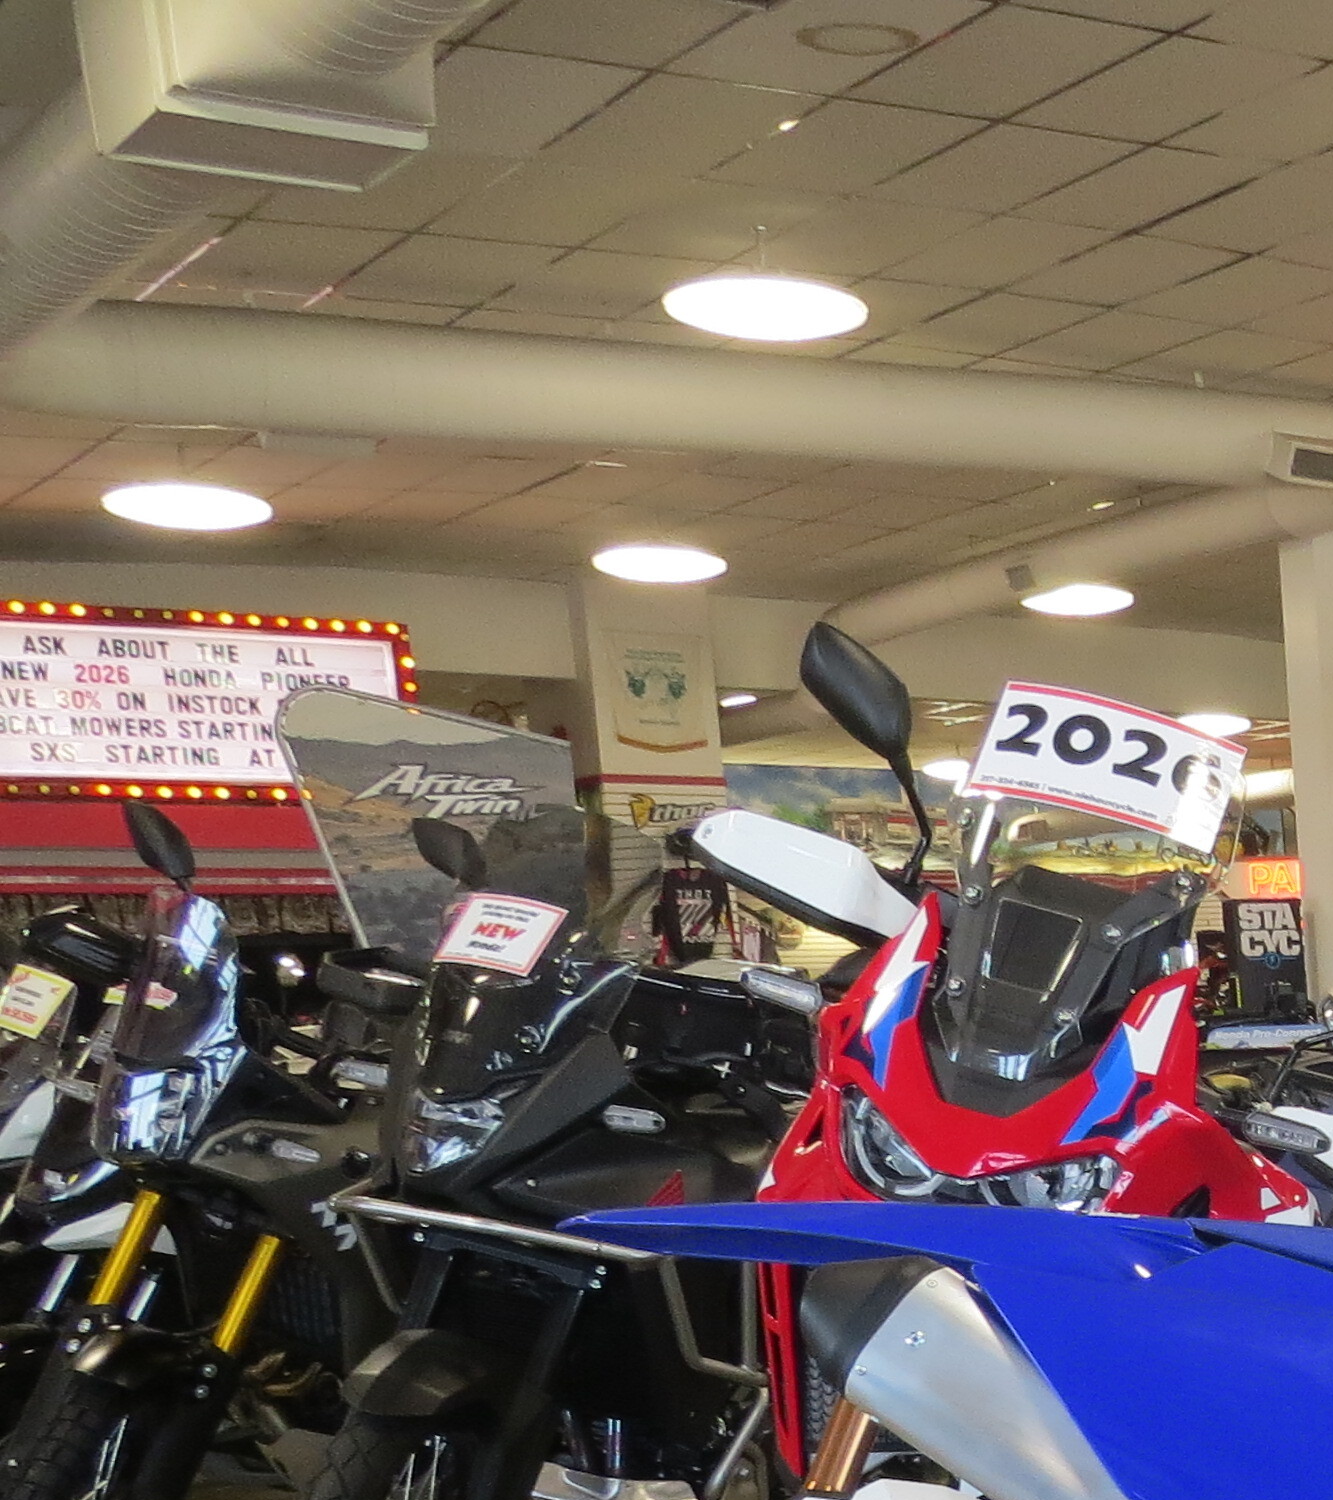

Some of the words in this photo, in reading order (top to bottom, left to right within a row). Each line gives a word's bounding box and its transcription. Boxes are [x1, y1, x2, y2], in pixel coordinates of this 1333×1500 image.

[23, 634, 68, 656] ASK
[97, 638, 170, 660] ABOUT
[197, 641, 241, 664] THE
[275, 646, 315, 667] ALL
[1, 660, 50, 682] NEW
[74, 663, 130, 685] 2026
[162, 666, 238, 690] HONDA
[57, 689, 103, 711] 30%
[117, 692, 148, 712] ON
[168, 693, 262, 716] INSTOCK
[70, 717, 168, 738] MOWERS
[30, 742, 78, 763] SXS
[105, 744, 220, 767] STARTING
[249, 748, 276, 768] AT
[348, 762, 546, 804] Africa
[425, 794, 521, 819] Twin
[1238, 903, 1298, 930] STA
[471, 921, 527, 941] NEW
[1240, 930, 1300, 958] CYC
[1214, 1029, 1251, 1039] Honda
